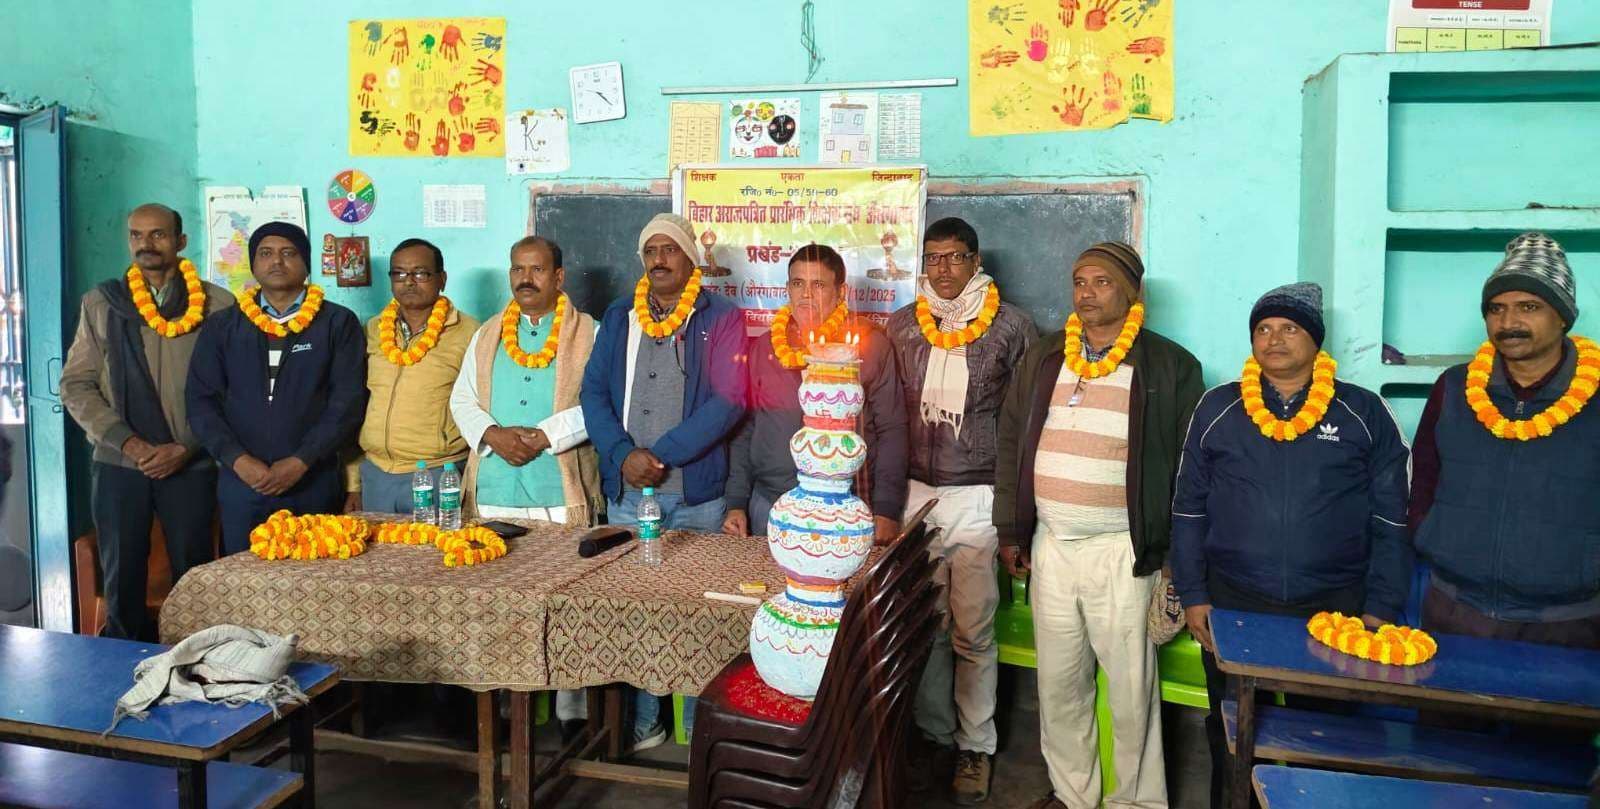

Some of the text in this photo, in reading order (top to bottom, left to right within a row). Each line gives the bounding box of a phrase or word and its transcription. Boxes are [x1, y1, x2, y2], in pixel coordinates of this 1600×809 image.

[1458, 1, 1483, 9] TENSE
[690, 170, 717, 182] शिक्षक
[780, 172, 805, 184] एकता
[688, 200, 714, 223] बिहार
[715, 200, 767, 223] अराजपत्रित
[1316, 434, 1340, 442] adidas
